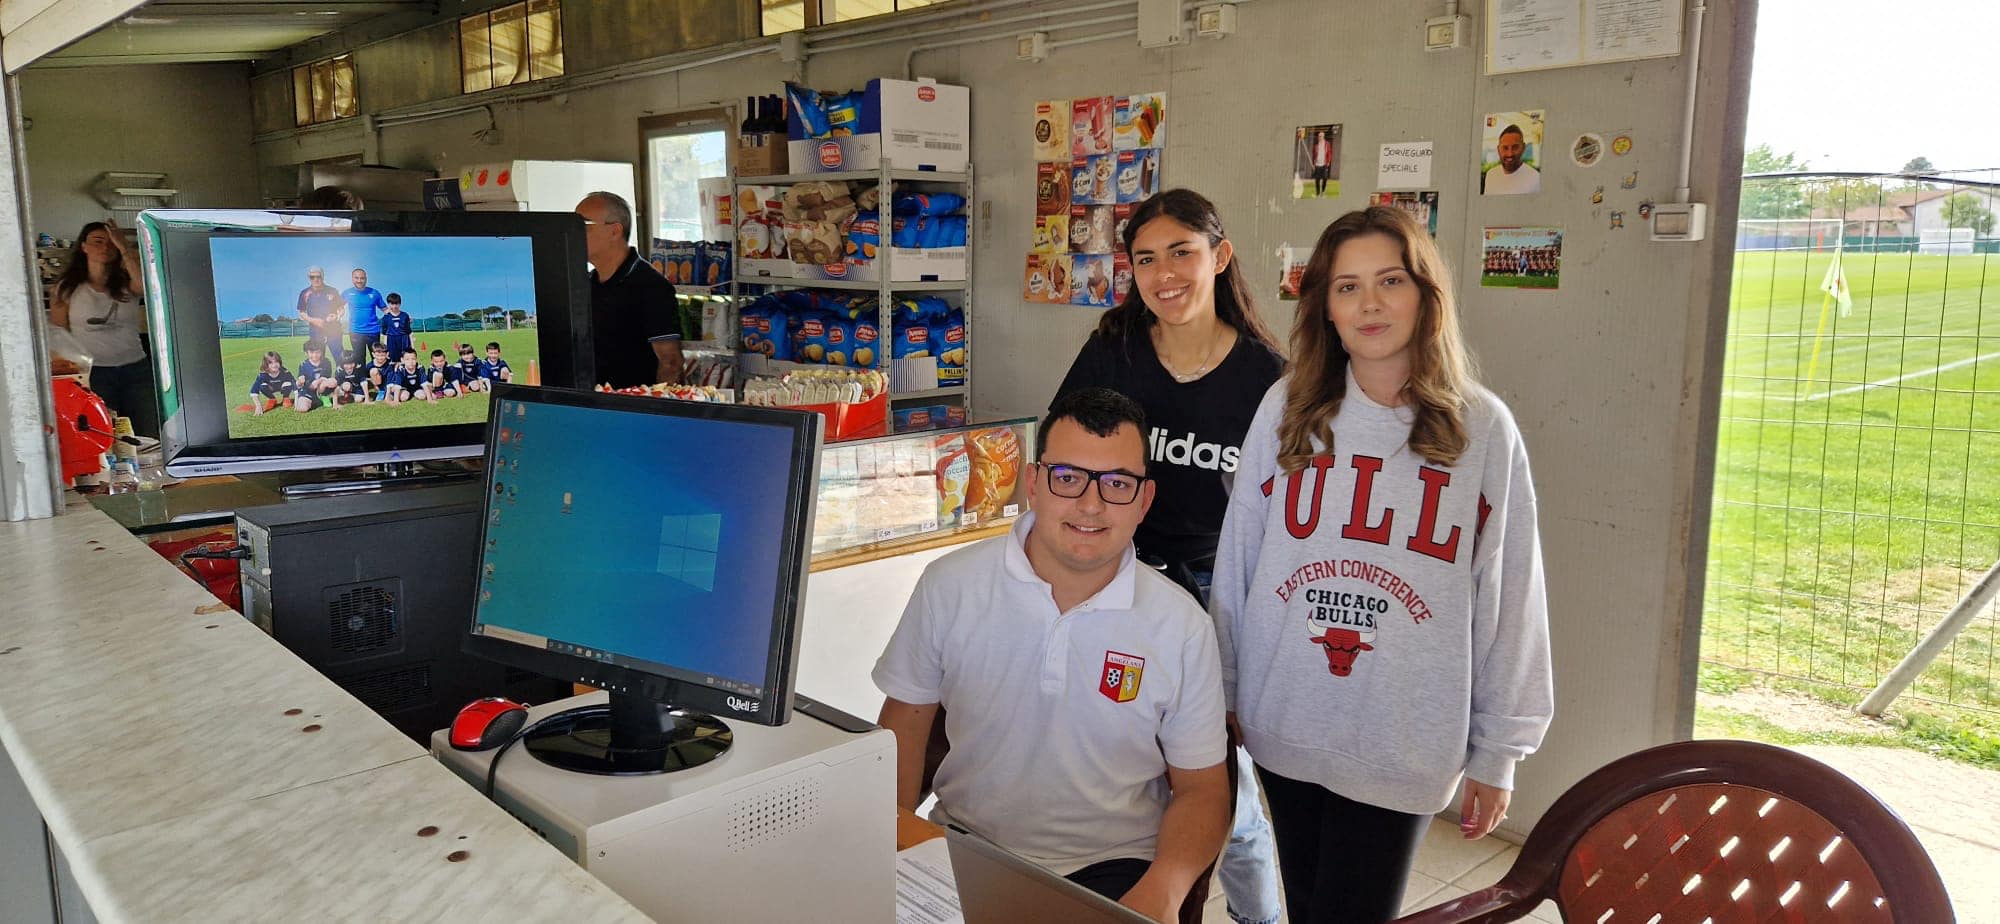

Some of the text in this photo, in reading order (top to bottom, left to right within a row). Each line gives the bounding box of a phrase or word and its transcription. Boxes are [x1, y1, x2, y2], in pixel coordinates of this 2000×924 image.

[1275, 559, 1433, 624] EASTERN CONFERENCE
[1305, 588, 1389, 614] CHICAGO
[1315, 606, 1374, 628] BULLS
